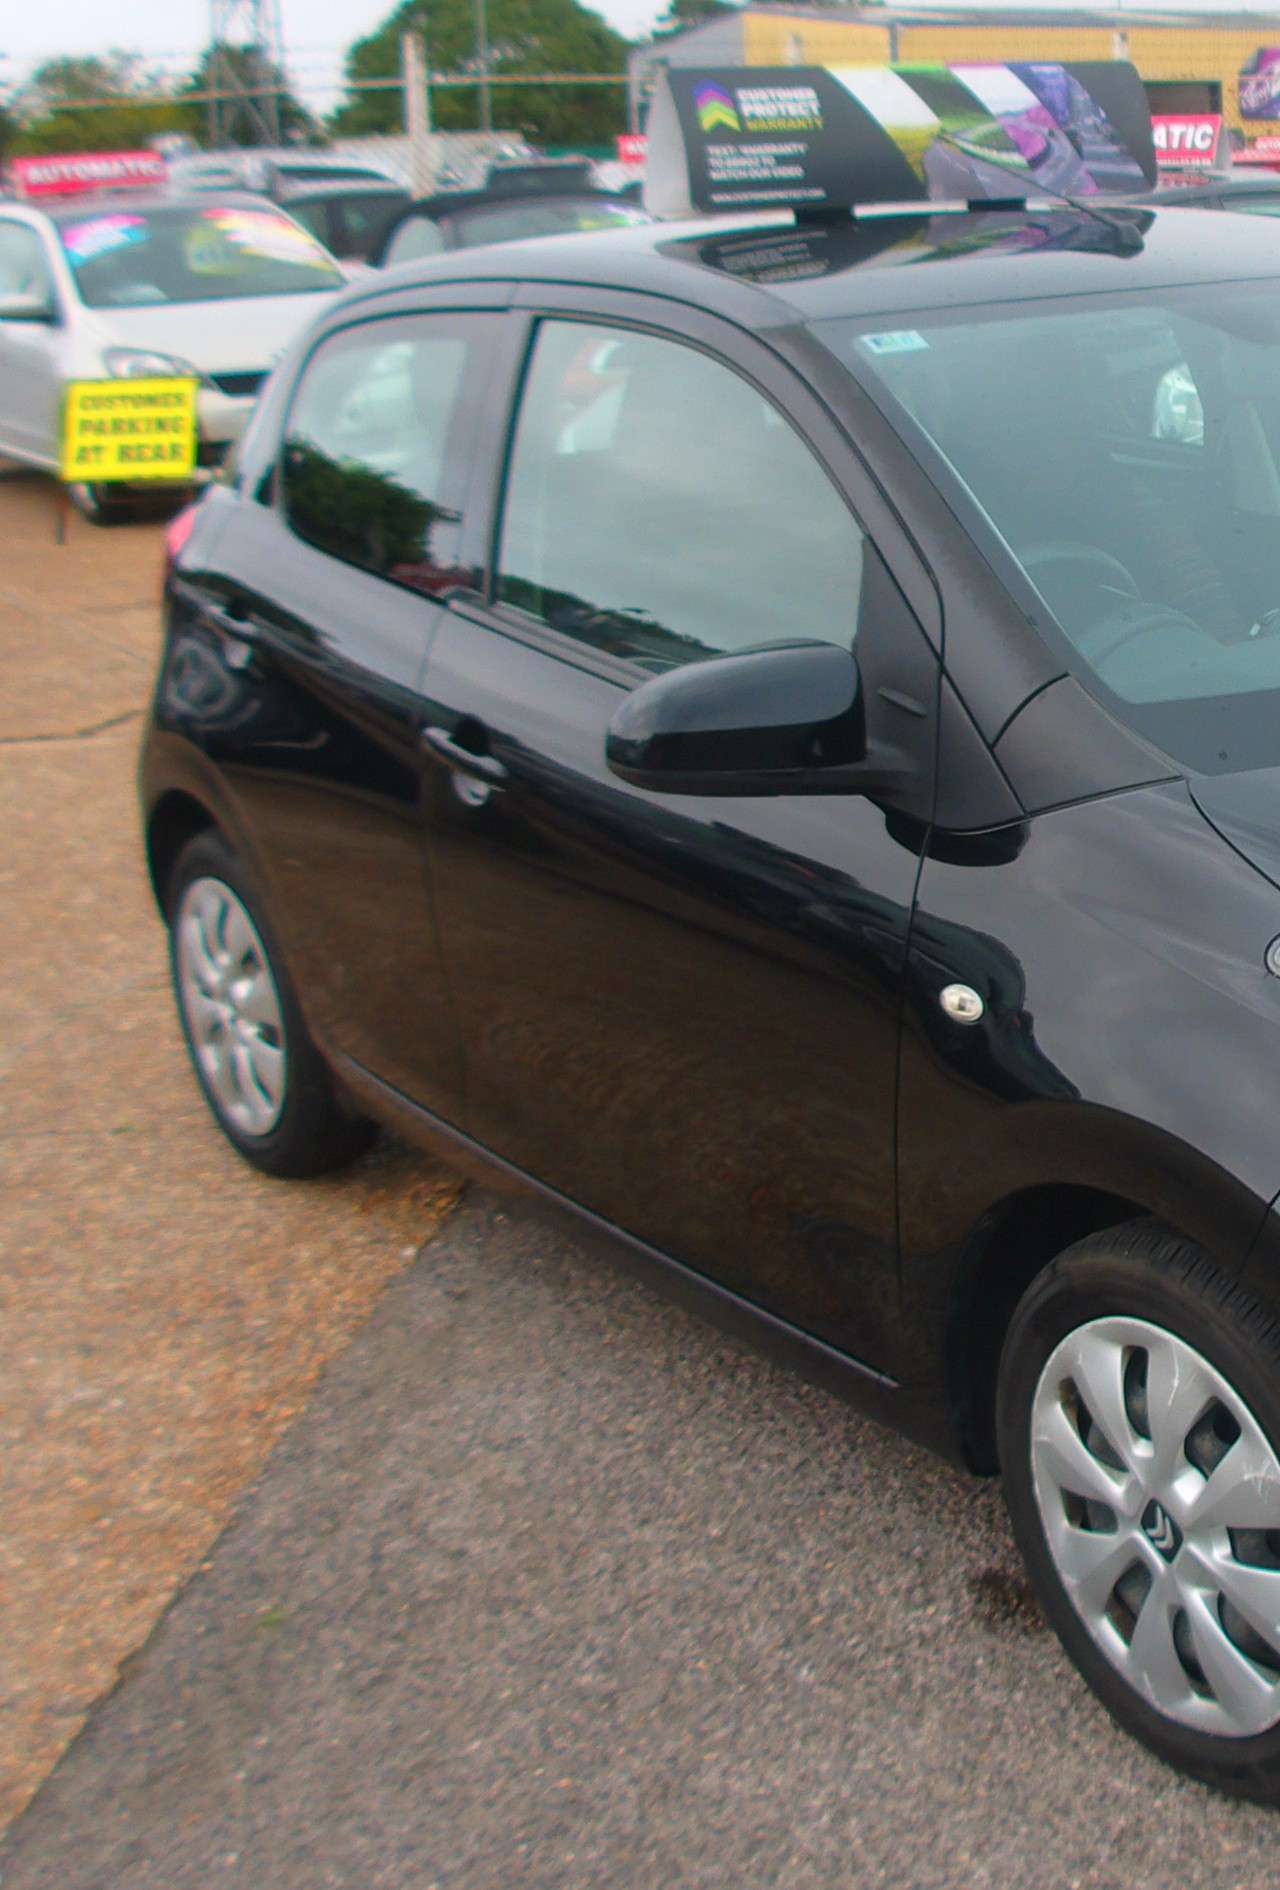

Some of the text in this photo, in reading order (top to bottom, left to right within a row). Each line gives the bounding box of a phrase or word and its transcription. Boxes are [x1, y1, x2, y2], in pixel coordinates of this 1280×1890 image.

[741, 101, 821, 118] PROTECT
[745, 117, 823, 130] WARRANTY
[79, 392, 186, 411] CUSTOMER
[79, 415, 186, 436] PARKING
[75, 442, 186, 465] AT REAR
